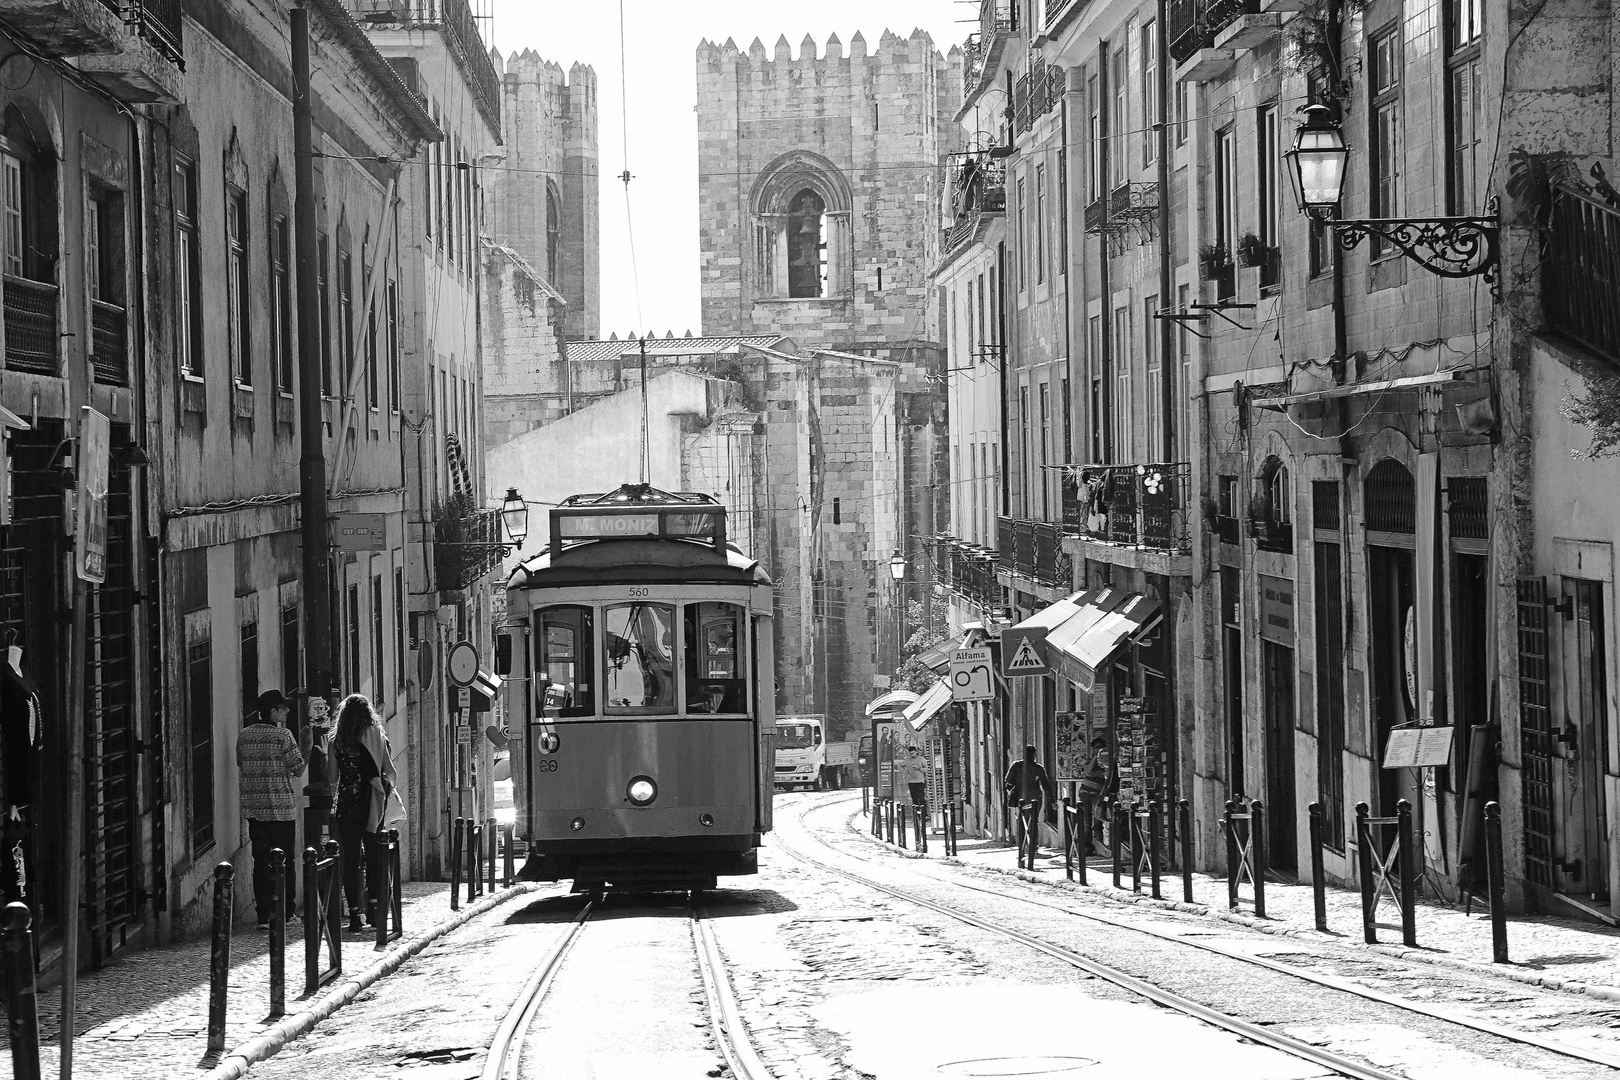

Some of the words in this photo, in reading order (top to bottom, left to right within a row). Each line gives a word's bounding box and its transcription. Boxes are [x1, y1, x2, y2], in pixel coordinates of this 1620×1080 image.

[600, 518, 655, 531] MONIZ
[629, 587, 649, 597] 560
[956, 652, 986, 660] Alfama
